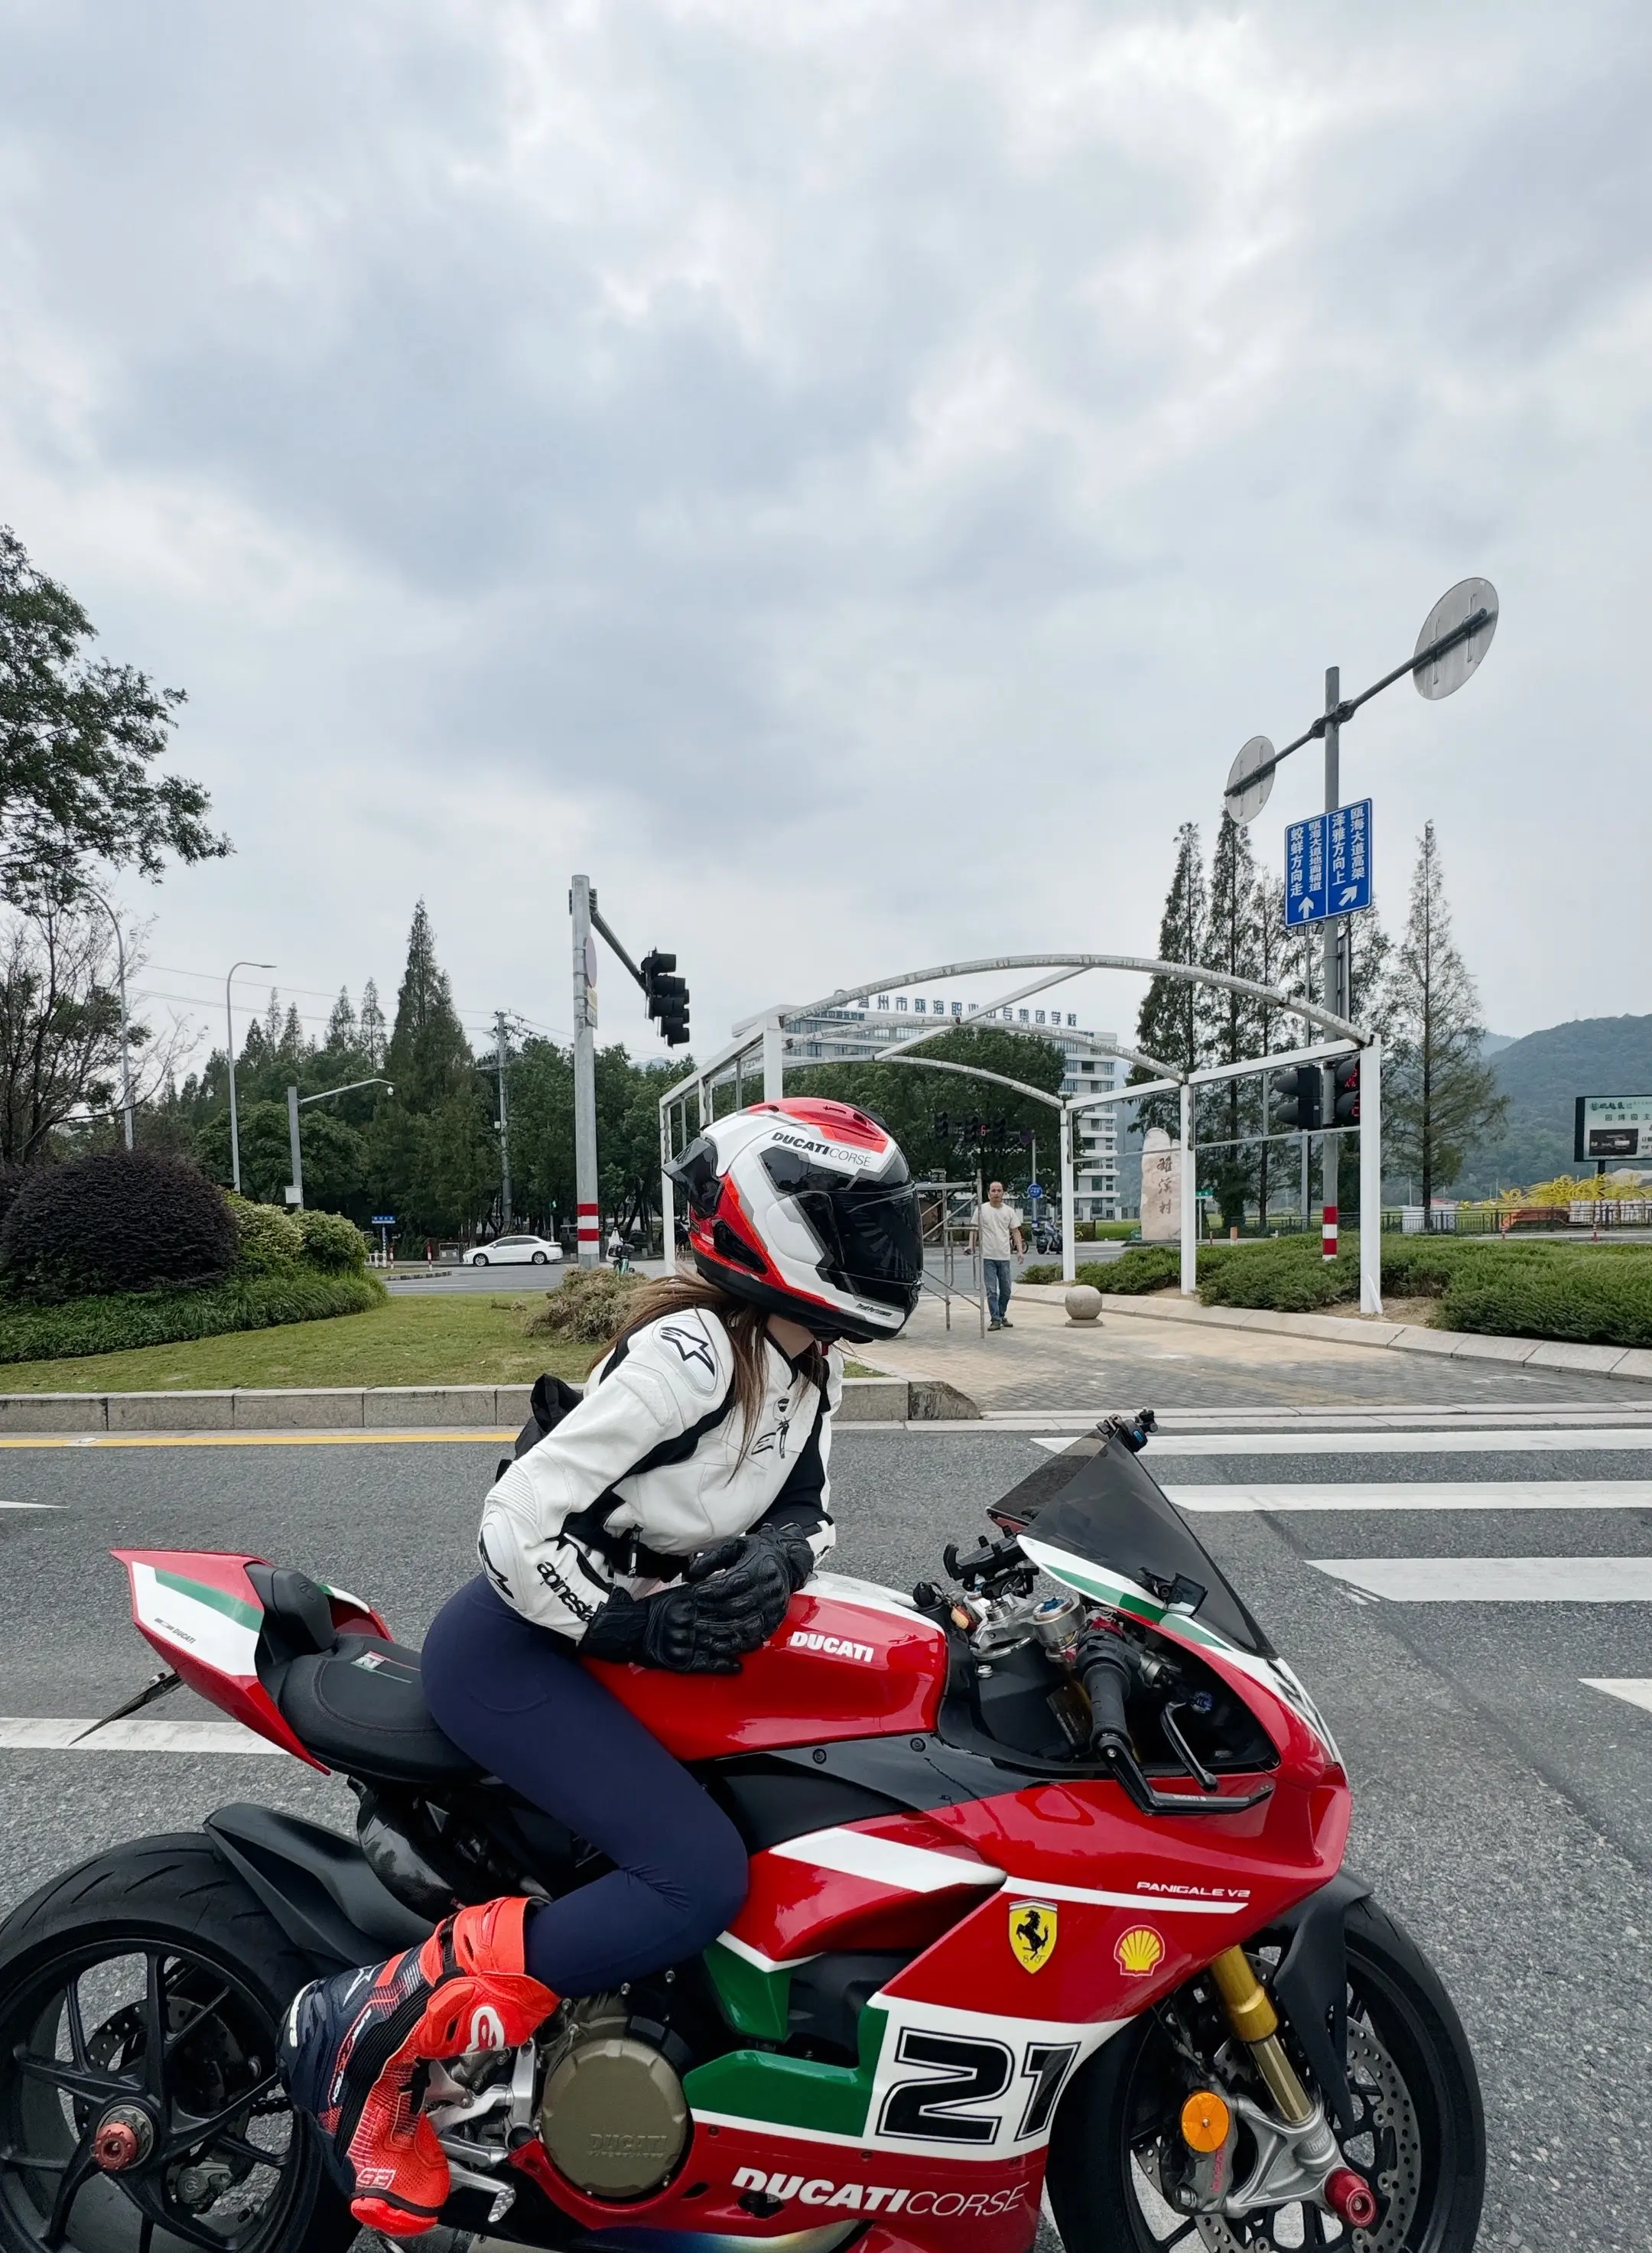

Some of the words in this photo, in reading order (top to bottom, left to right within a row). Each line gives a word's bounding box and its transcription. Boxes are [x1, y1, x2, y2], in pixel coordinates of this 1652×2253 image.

[1332, 812, 1345, 886] 泽雅方向上
[1351, 807, 1364, 880] 瓯海大道高架
[172, 1628, 197, 1644] DUCATI
[789, 1630, 874, 1663] DUCATI
[1137, 1881, 1225, 1897] PANIGALE
[1228, 1888, 1251, 1897] V2
[875, 2026, 1081, 2145] 21
